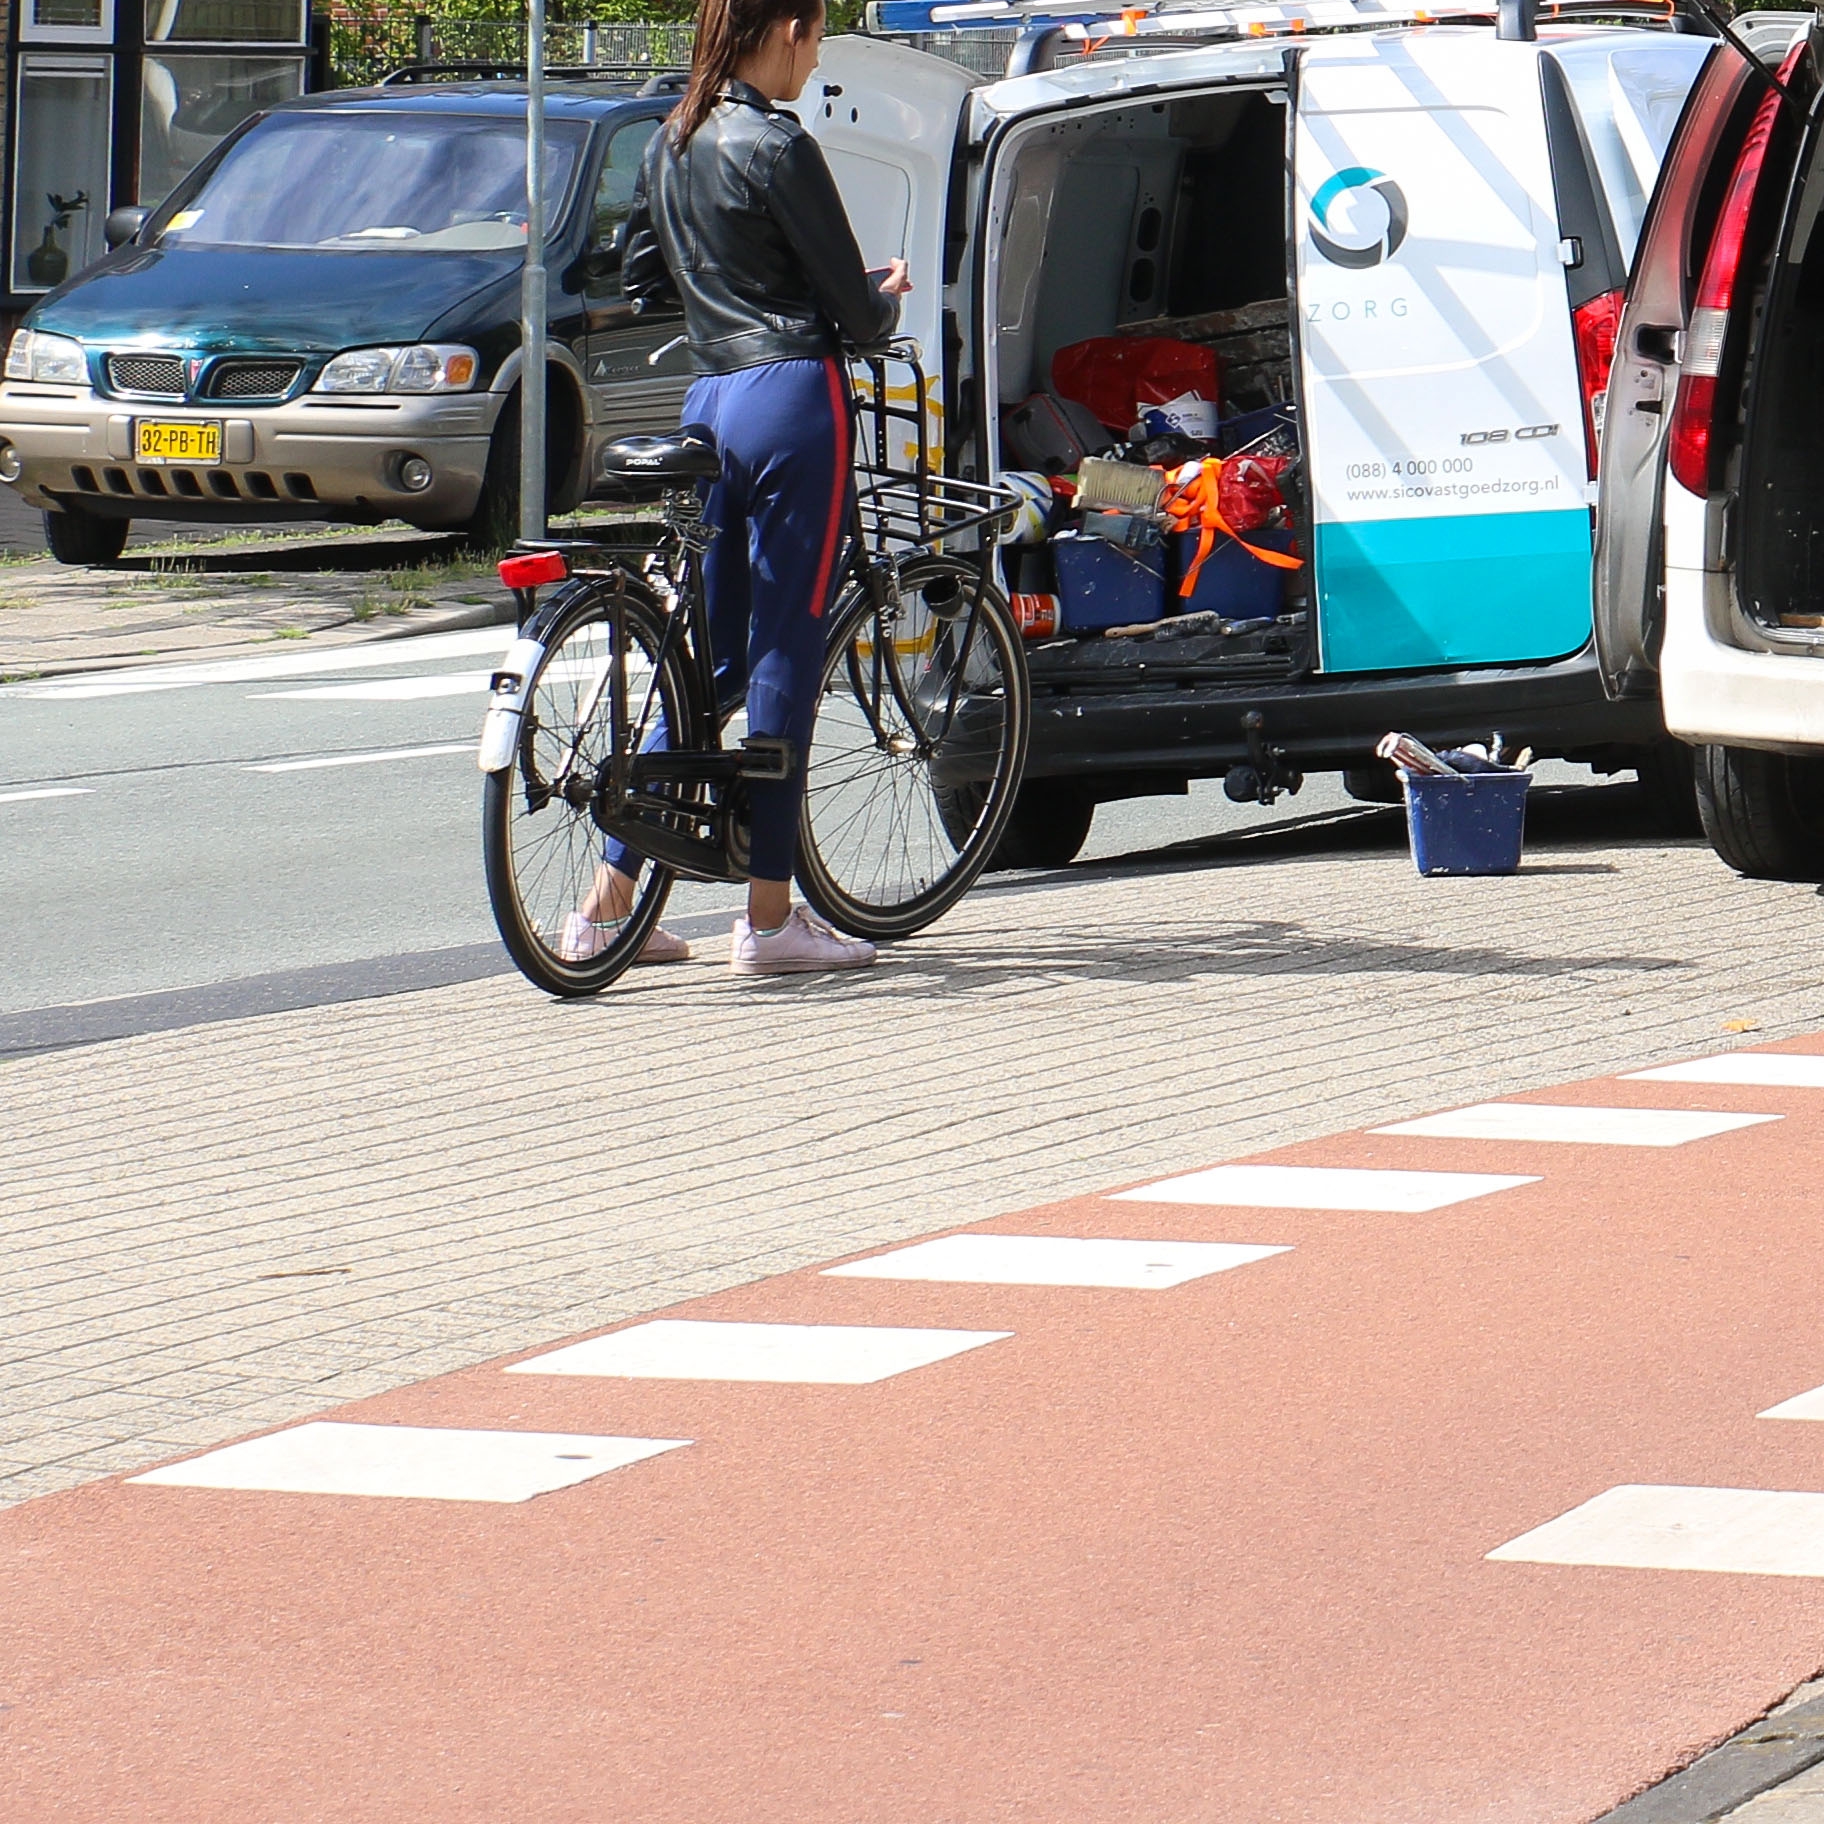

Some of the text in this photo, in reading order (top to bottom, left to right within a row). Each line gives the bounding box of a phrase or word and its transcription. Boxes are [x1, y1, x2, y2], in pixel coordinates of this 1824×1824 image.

[1307, 297, 1408, 323] ZORG
[142, 429, 217, 454] 32-PB-TH
[1460, 429, 1509, 446] 108
[1346, 457, 1473, 480] (088) 4 000 000
[1347, 475, 1560, 501] www.sicovastgoedzorg.nl
